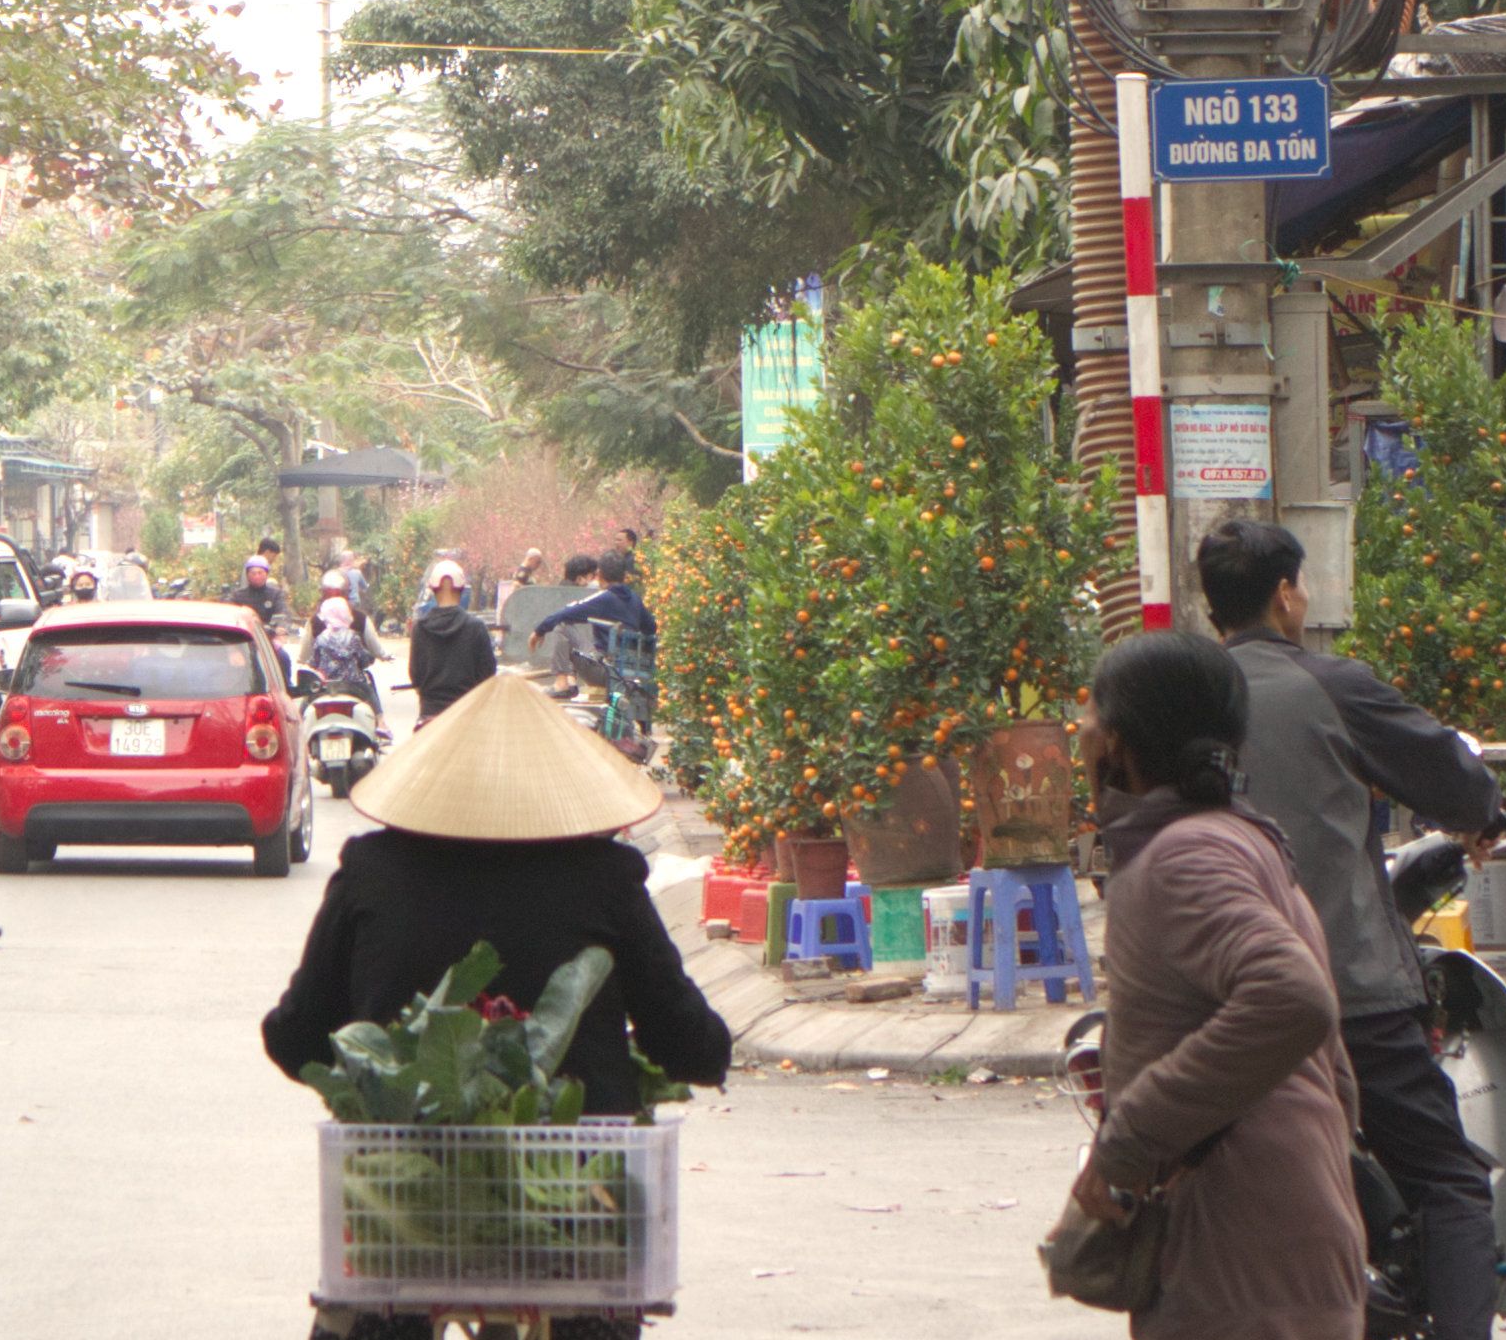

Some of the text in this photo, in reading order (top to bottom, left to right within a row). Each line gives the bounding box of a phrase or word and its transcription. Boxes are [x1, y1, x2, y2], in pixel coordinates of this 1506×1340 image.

[1183, 88, 1298, 126] NGÕ 133
[1168, 128, 1317, 165] ĐƯỜNG ĐA TỐN
[124, 721, 151, 736] 30E
